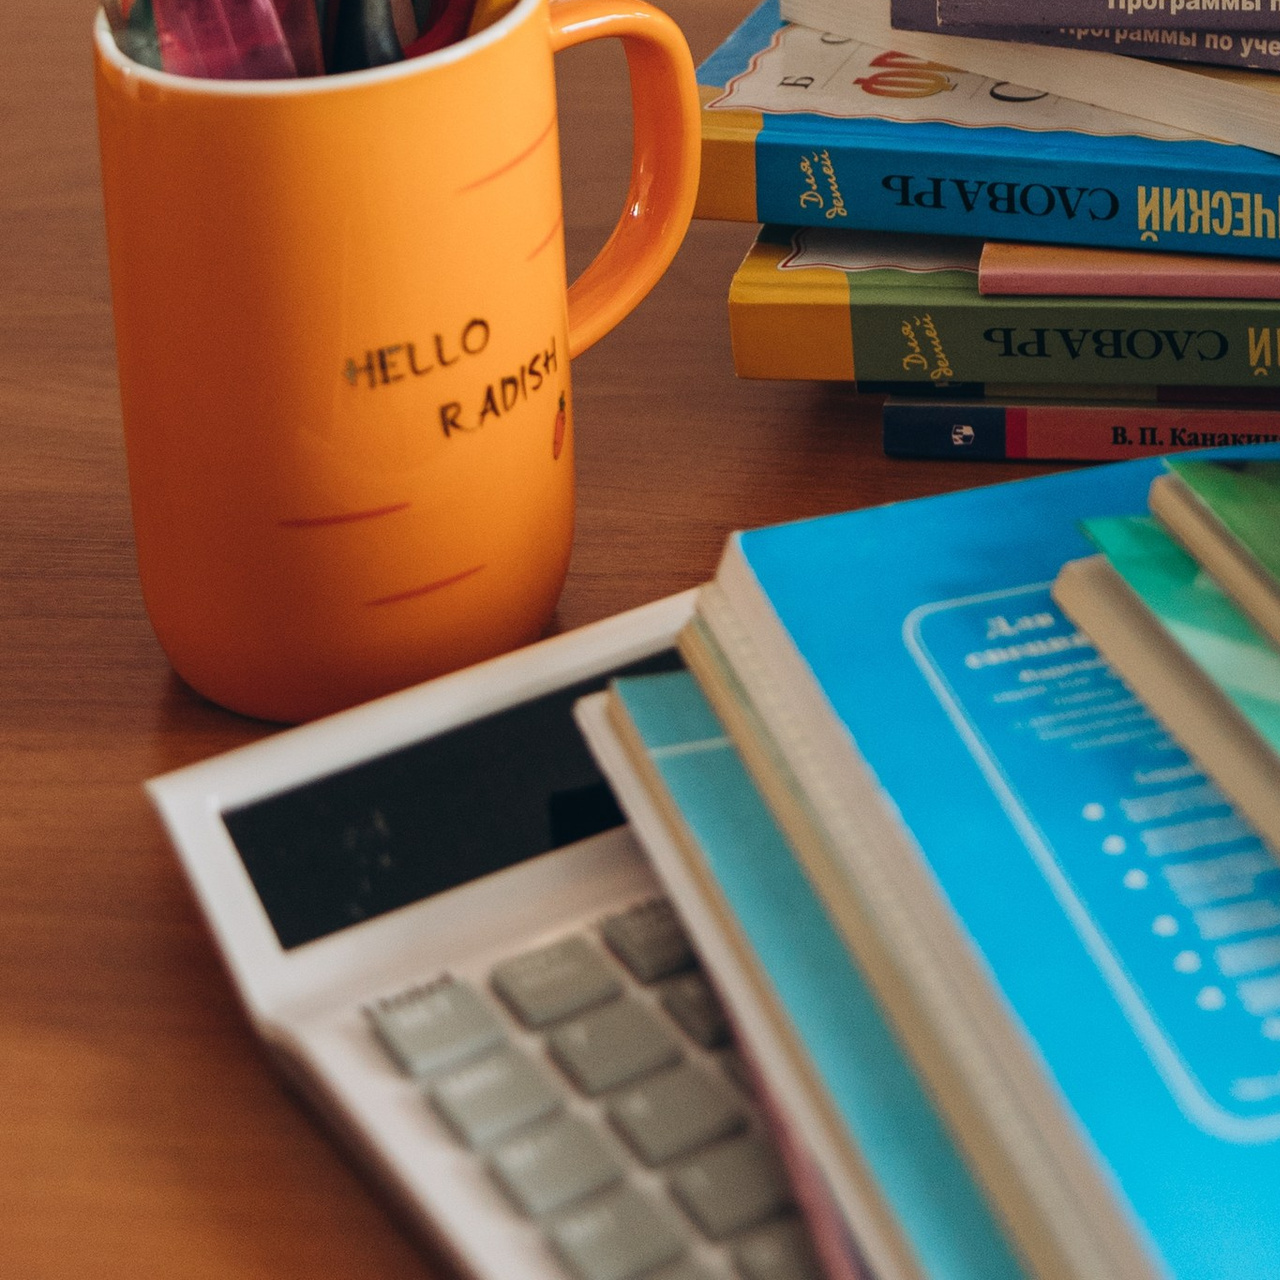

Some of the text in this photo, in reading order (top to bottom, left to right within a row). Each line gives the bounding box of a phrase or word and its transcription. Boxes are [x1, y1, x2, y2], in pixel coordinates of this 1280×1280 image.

[1058, 26, 1198, 47] рограммы
[1205, 32, 1234, 51] по
[880, 173, 1120, 222] СЛОВАРЬ
[343, 317, 491, 390] HELLO
[983, 327, 1229, 362] СЛОВАРЬ
[438, 335, 560, 439] RADISH
[1111, 427, 1132, 446] В.
[1139, 428, 1164, 447] П.
